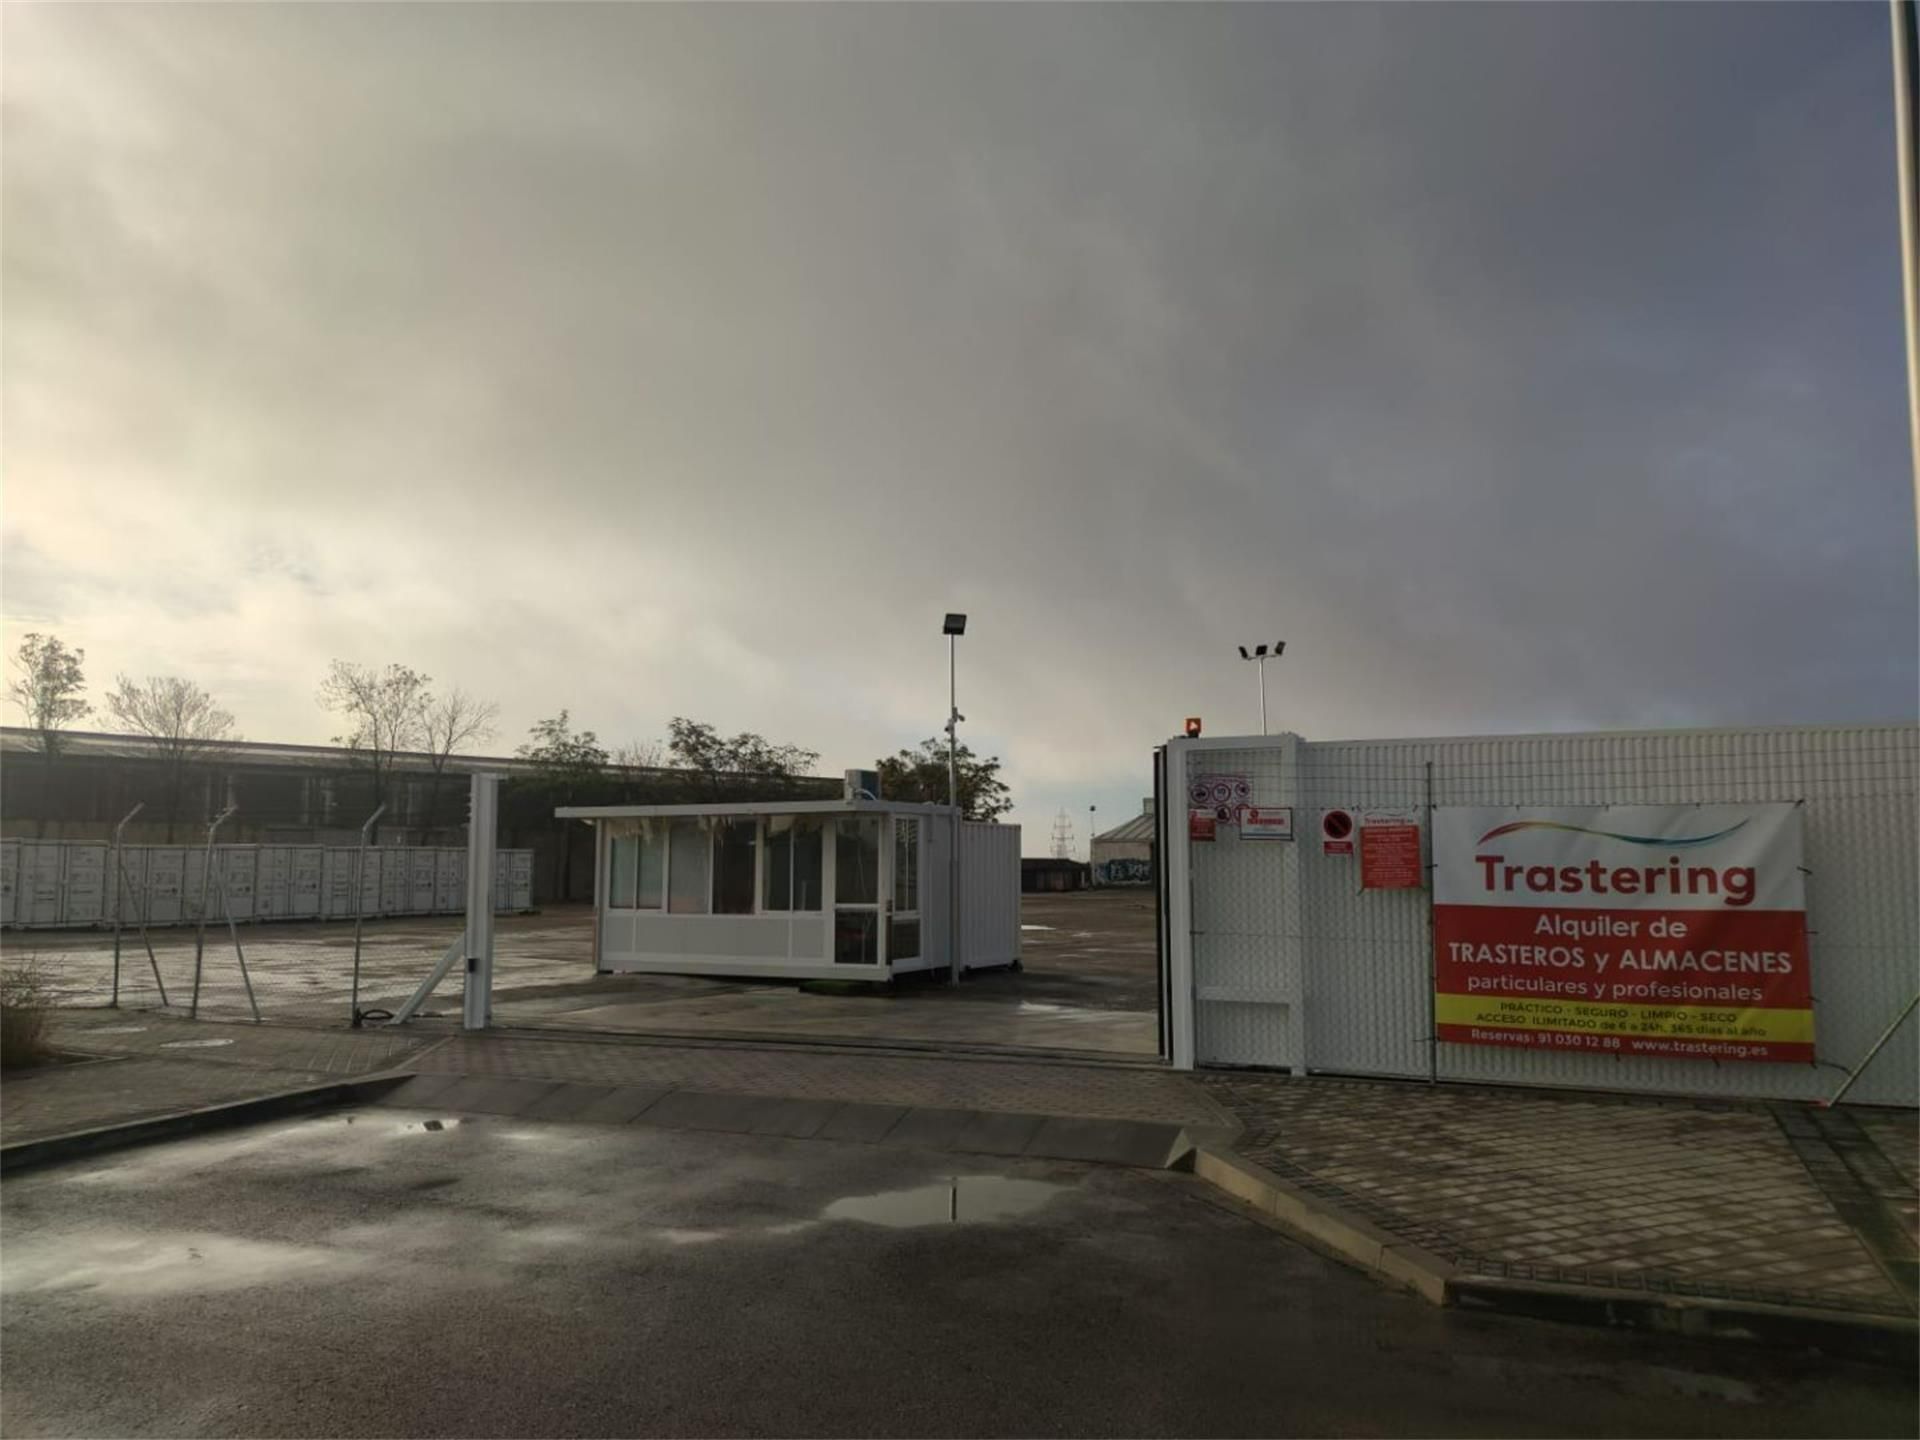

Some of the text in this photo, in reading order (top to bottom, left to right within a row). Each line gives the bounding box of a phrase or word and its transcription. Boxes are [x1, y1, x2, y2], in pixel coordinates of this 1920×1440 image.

[1475, 855, 1756, 906] Trastering
[1534, 914, 1688, 940] Alquiler de
[1448, 942, 1793, 974] TRASTEROS y ALMACENES
[1467, 975, 1763, 1001] particulares y profesionales
[1476, 1013, 1527, 1025] ACCESO
[1532, 1016, 1597, 1029] ILIMITADO
[1600, 1021, 1616, 1030] de
[1618, 1021, 1627, 1030] 6
[1671, 1024, 1694, 1034] 365
[1727, 1026, 1738, 1035] al
[1575, 1006, 1629, 1018] SEGURO
[1640, 1010, 1688, 1021] LIMPIO
[1700, 1012, 1738, 1023] SECO
[1471, 1029, 1534, 1044] Reservas:
[1537, 1032, 1552, 1044] 91
[1555, 1034, 1582, 1046] 030
[1586, 1035, 1600, 1047] 12
[1631, 1040, 1769, 1057] www.trastering.es
